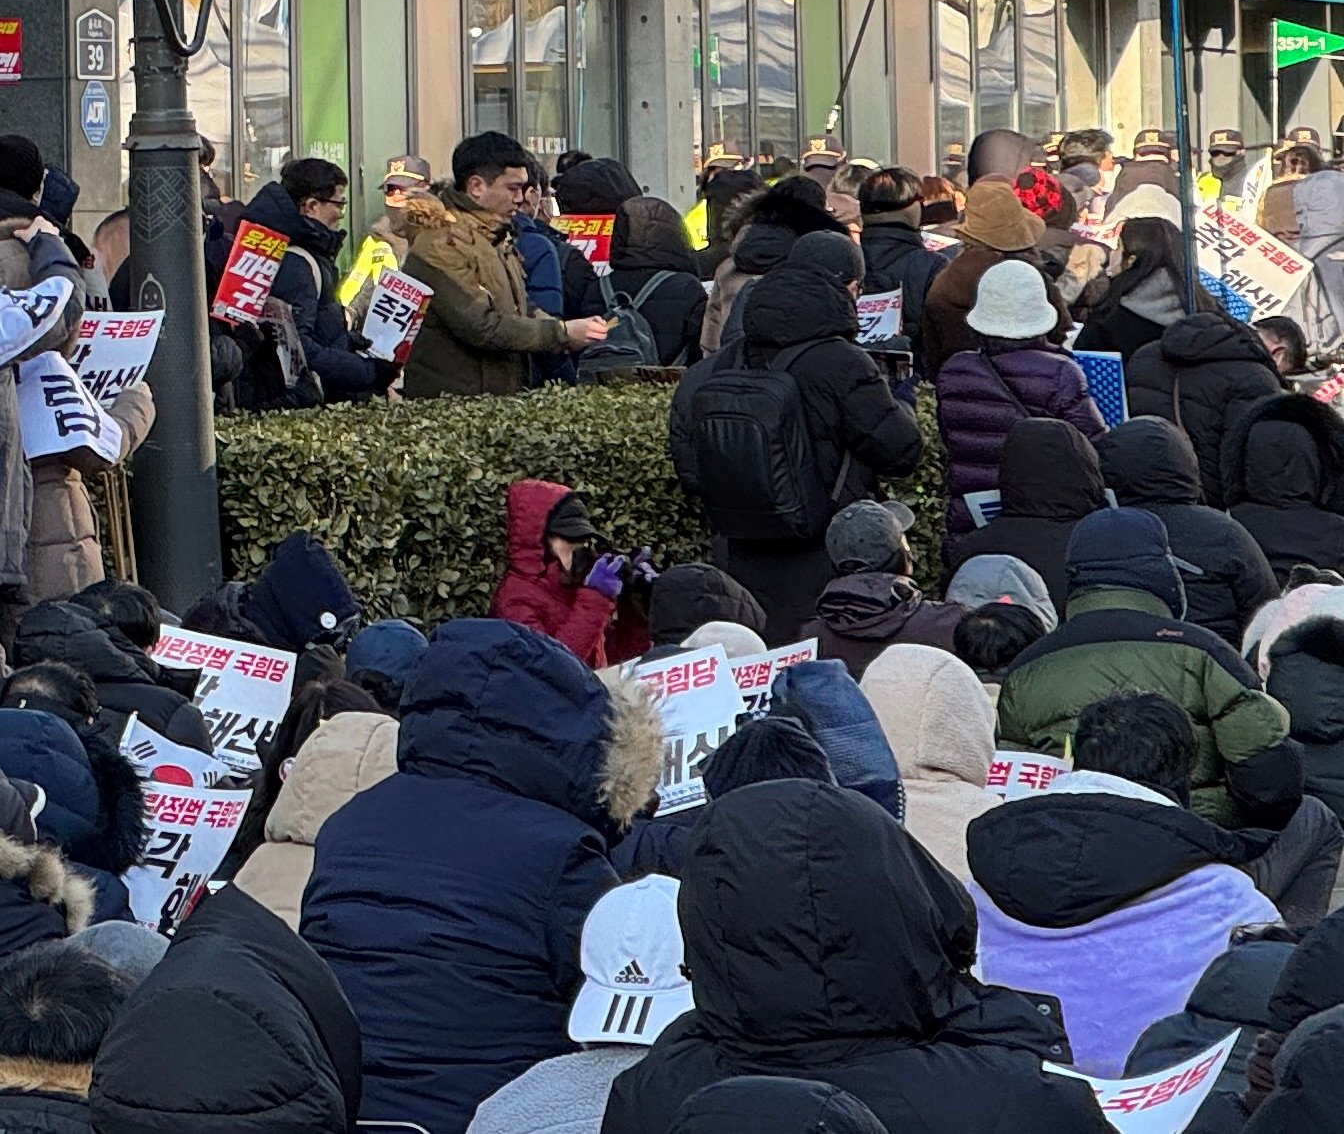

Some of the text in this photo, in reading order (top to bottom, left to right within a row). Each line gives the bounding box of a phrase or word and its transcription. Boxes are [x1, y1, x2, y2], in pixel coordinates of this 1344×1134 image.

[87, 44, 104, 71] 39
[86, 101, 105, 125] ADT
[1257, 241, 1304, 275] 국힘당
[371, 293, 417, 333] 즉각
[102, 319, 157, 340] 국힘당
[232, 651, 291, 683] 국힘당
[142, 792, 207, 827] 란정범
[614, 975, 651, 985] adidas
